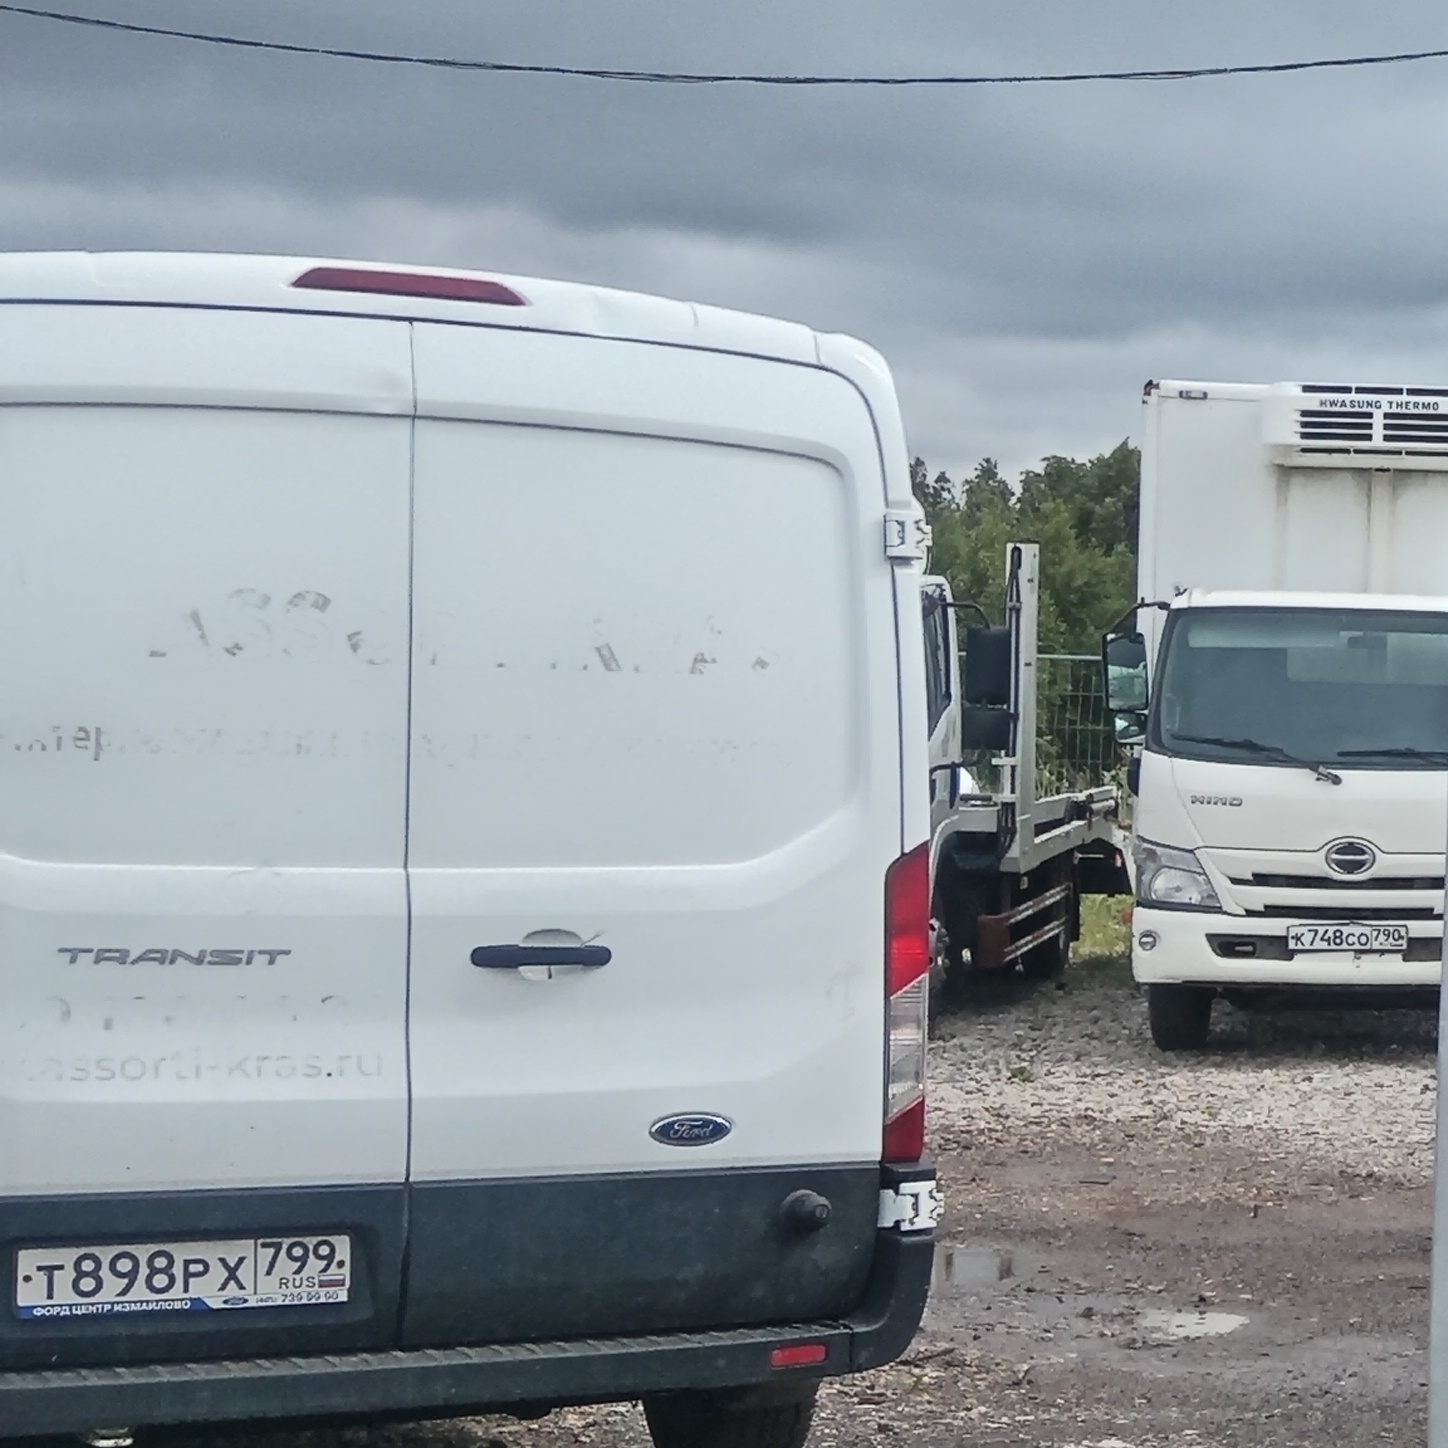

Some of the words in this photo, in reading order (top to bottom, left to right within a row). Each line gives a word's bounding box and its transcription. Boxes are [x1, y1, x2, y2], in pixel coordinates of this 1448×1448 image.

[1319, 399, 1382, 410] HWASUNG
[1388, 400, 1440, 411] THERMO
[1190, 795, 1243, 807] HINO
[1295, 928, 1370, 947] К748СО
[1372, 928, 1401, 942] 790
[58, 948, 292, 966] TRANSIT
[36, 1250, 248, 1300] Т898РХ
[260, 1239, 337, 1277] 799
[279, 1277, 316, 1289] RUS
[33, 1306, 70, 1317] ФОРД
[72, 1303, 112, 1315] ЦЕНТР
